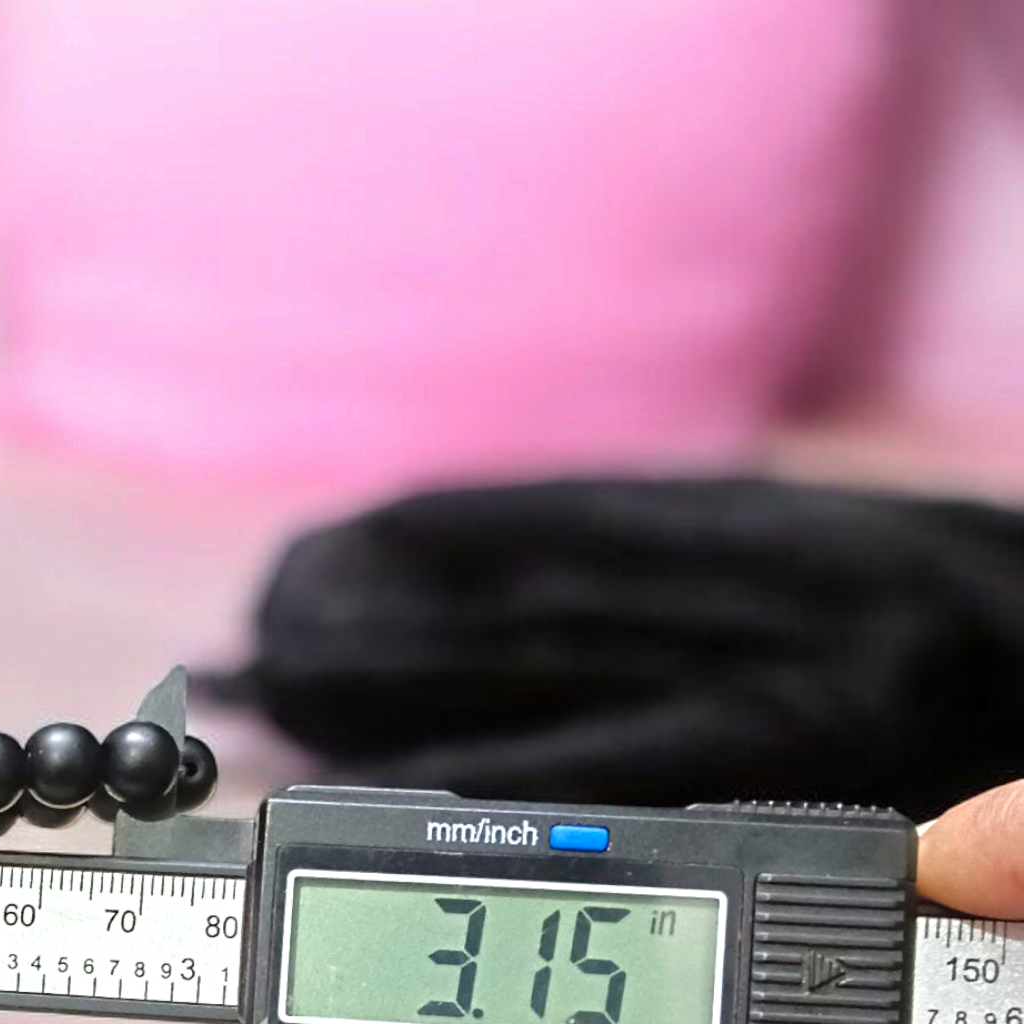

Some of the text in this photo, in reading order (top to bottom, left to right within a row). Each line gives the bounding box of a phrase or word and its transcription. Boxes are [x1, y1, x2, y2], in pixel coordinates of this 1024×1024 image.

[426, 818, 539, 847] mm/inch
[3, 903, 36, 928] 60
[104, 908, 137, 934] 70
[204, 914, 238, 939] 80
[650, 909, 676, 936] in
[7, 953, 19, 970] 3
[30, 955, 42, 971] 4
[58, 956, 69, 973] 5
[83, 958, 95, 975] 6
[110, 959, 120, 976] 7
[134, 961, 146, 978] 8
[160, 962, 172, 980] 9
[180, 957, 196, 981] 3
[221, 967, 228, 982] 1
[946, 957, 999, 984] 150
